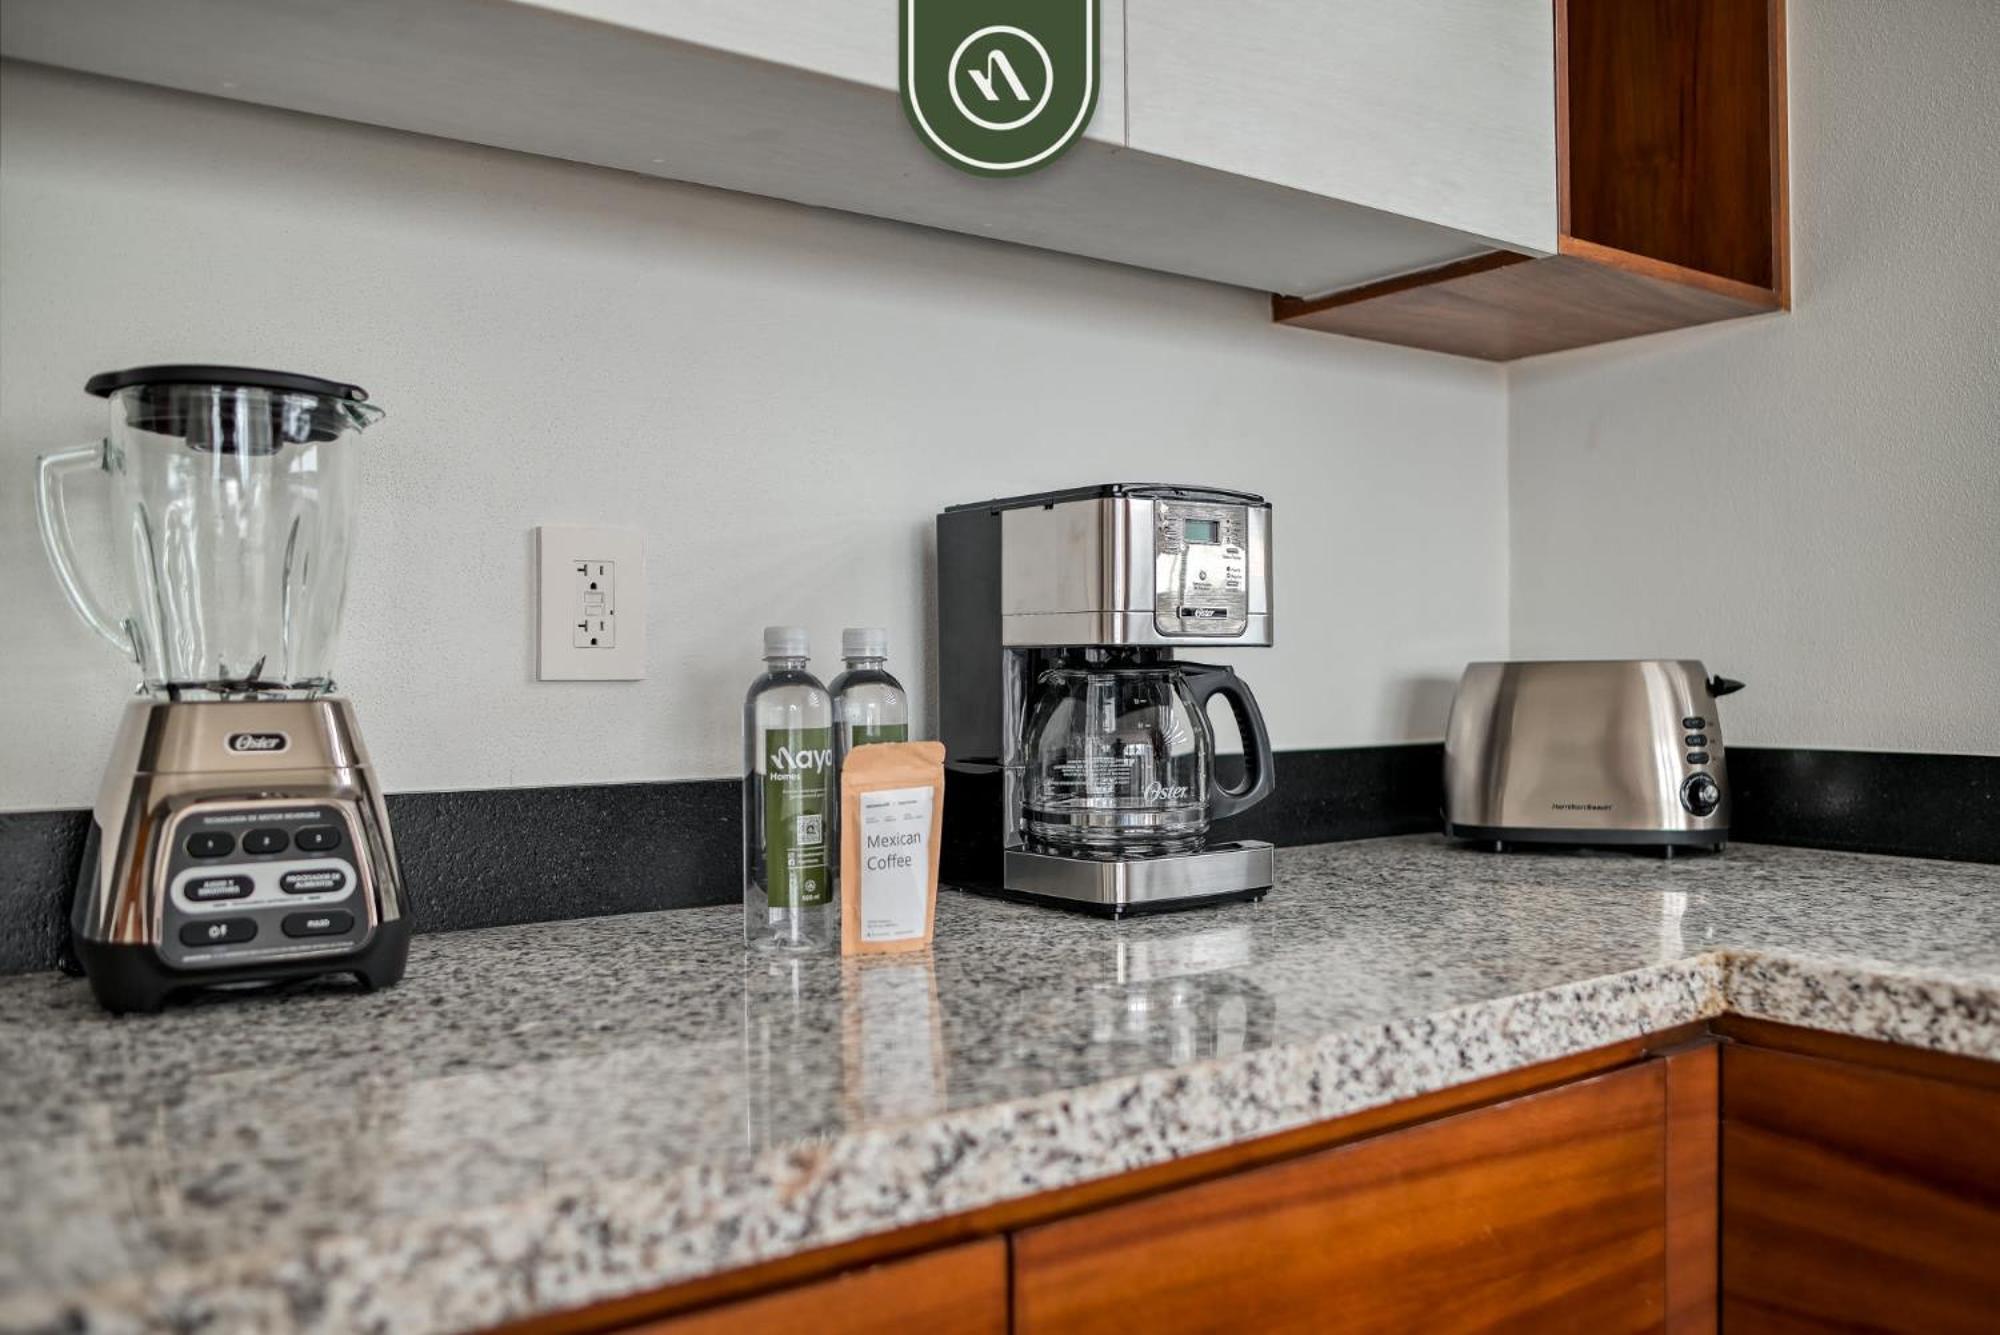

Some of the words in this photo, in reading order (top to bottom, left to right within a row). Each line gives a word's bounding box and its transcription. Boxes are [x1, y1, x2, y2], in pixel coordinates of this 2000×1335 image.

[1194, 608, 1215, 617] Oster
[235, 735, 280, 750] Oster
[770, 772, 800, 782] Homes
[1144, 781, 1188, 802] Oster
[867, 832, 921, 849] Mexican
[867, 853, 912, 871] Coffee
